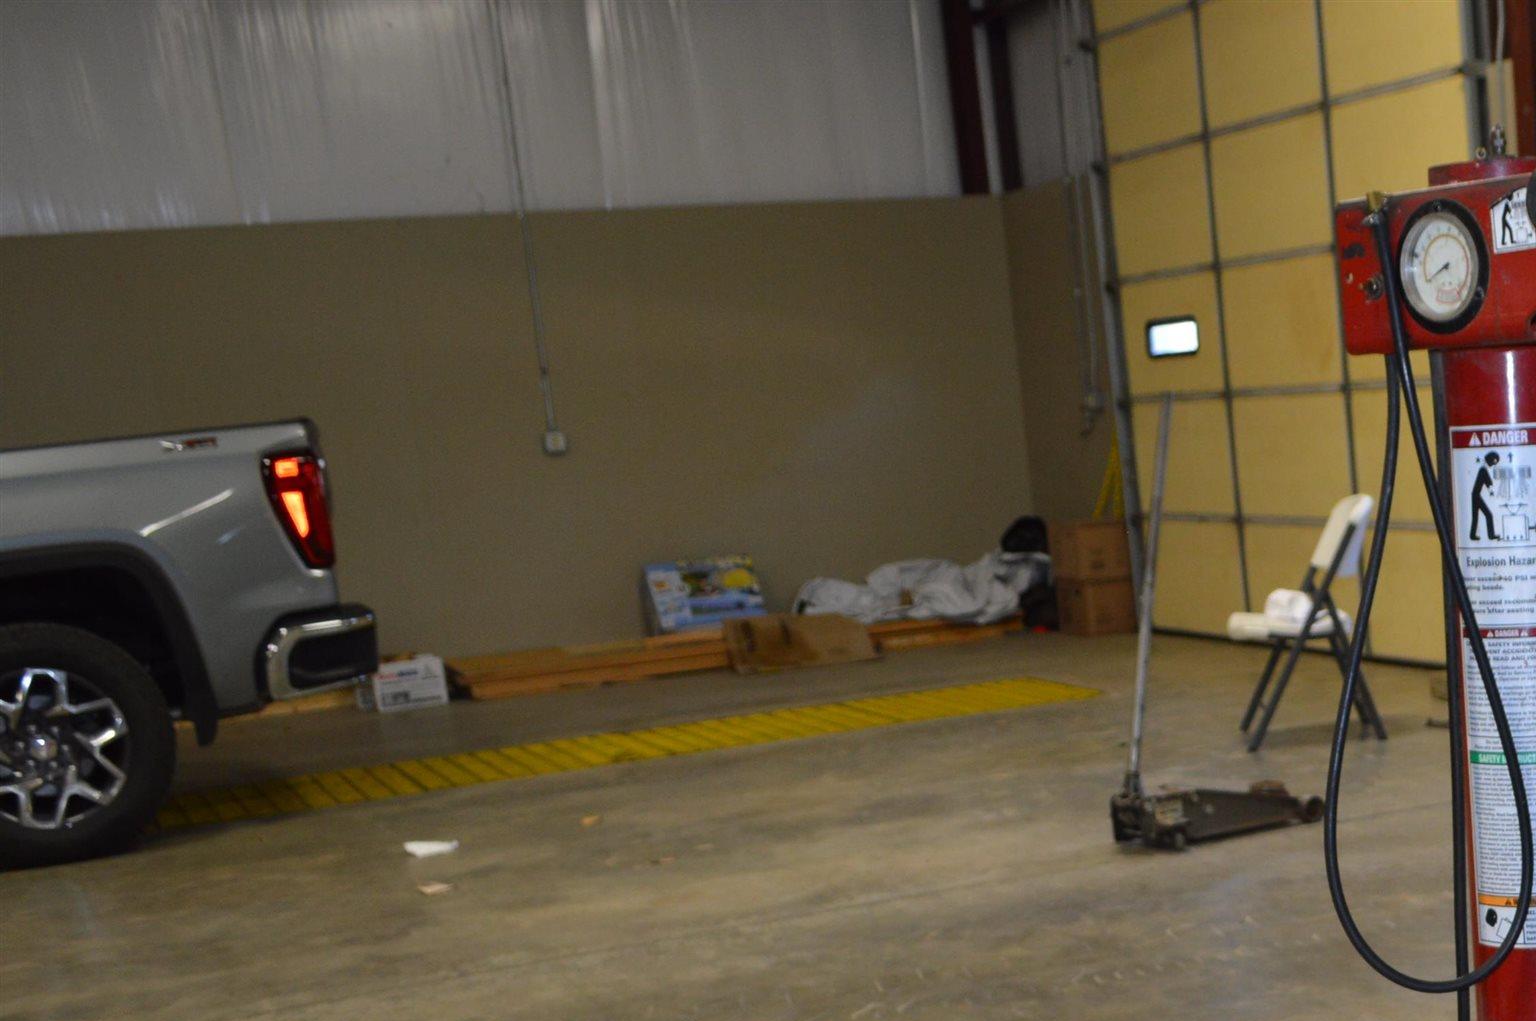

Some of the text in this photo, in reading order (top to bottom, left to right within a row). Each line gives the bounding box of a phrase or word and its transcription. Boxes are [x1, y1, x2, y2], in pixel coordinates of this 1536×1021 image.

[1482, 429, 1529, 445] DANGER
[1466, 556, 1507, 568] Explosion
[1478, 753, 1500, 763] SAFETY
